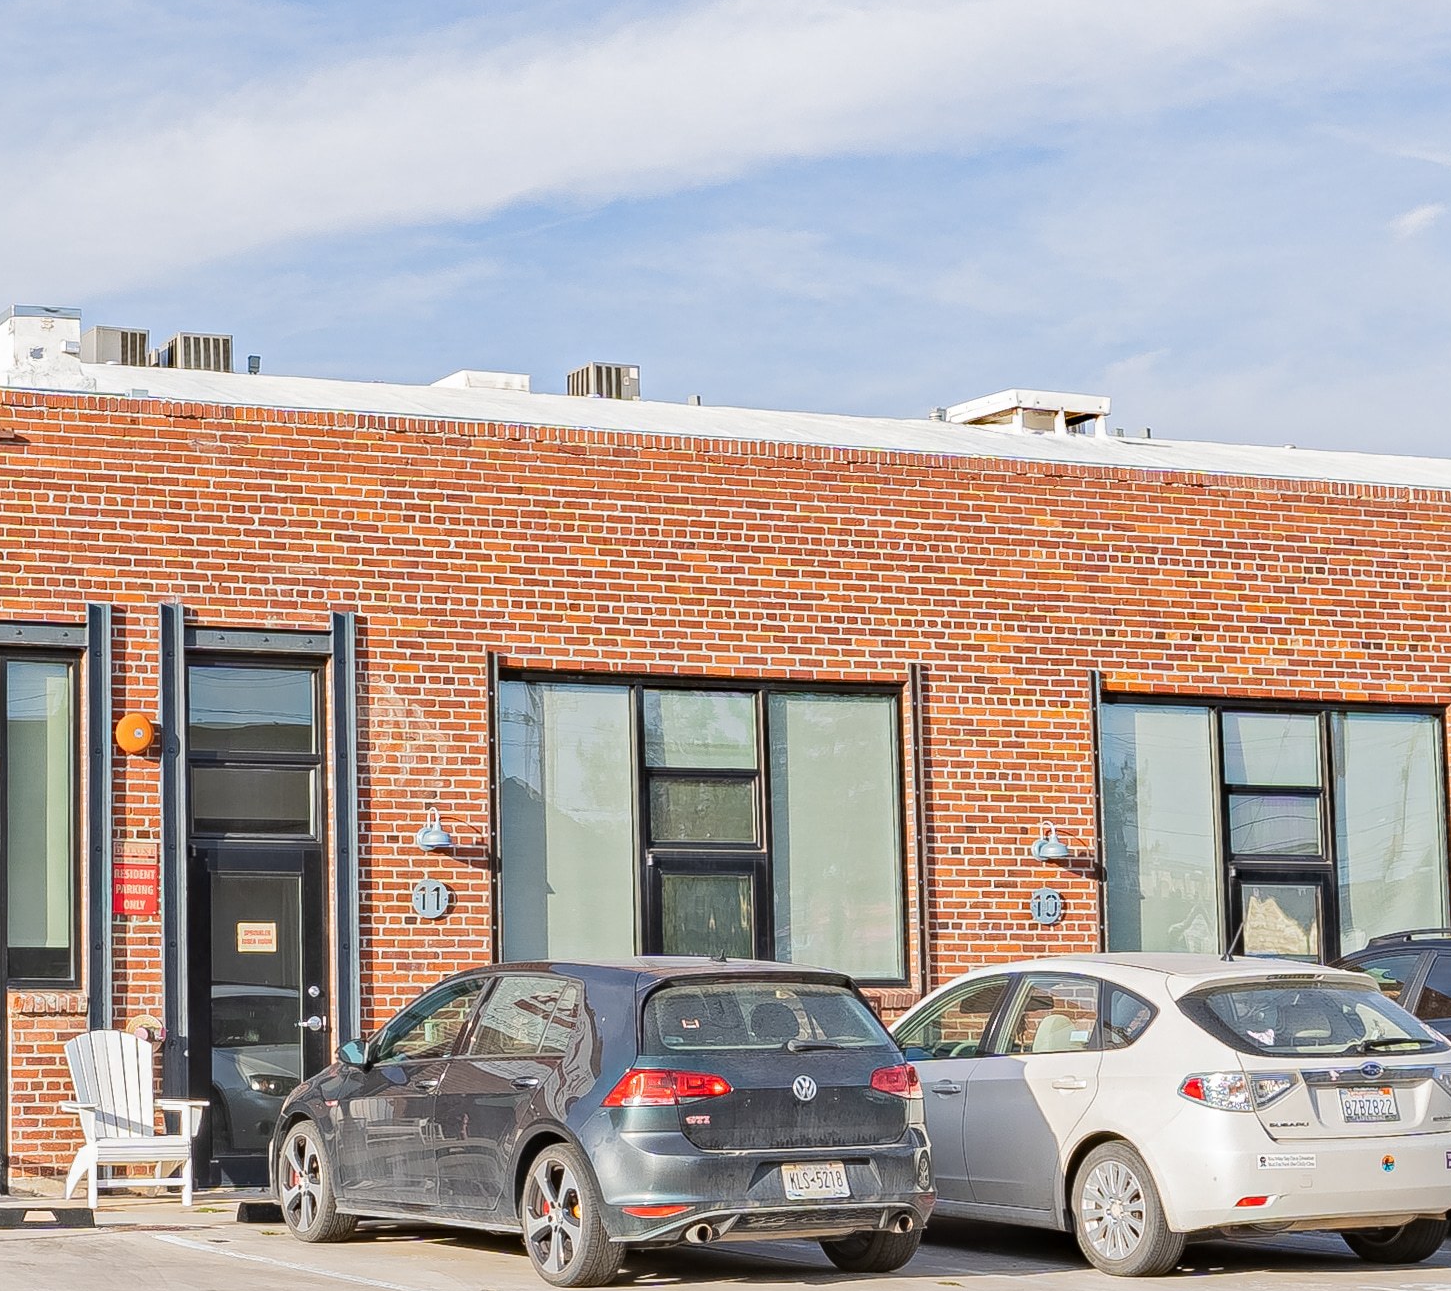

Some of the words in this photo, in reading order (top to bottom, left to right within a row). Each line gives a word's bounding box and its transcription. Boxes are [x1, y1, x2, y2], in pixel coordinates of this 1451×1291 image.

[114, 869, 156, 880] RESIDENT
[115, 884, 154, 895] PARKING
[123, 899, 146, 910] ONLY
[418, 886, 441, 911] 11
[1034, 894, 1058, 917] 10
[1345, 1099, 1393, 1116] 8ZBZ822
